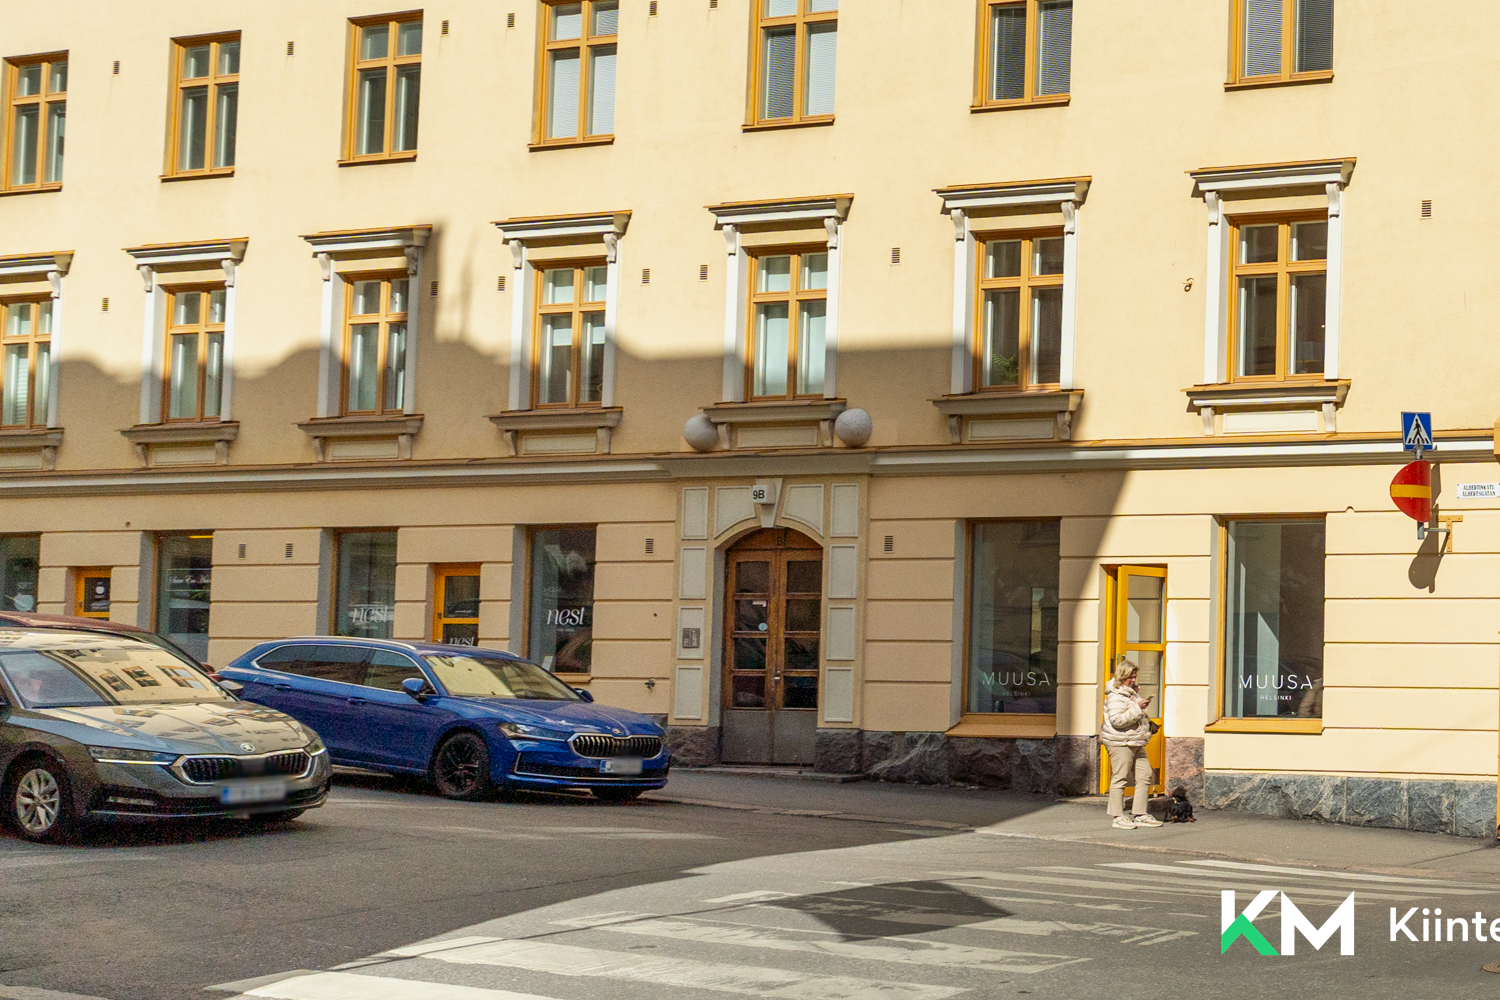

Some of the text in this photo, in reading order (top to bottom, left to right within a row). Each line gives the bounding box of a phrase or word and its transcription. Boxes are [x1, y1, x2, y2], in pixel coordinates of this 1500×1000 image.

[753, 489, 765, 500] 9B
[546, 607, 585, 626] nest
[982, 671, 1051, 686] MUUSA
[1238, 674, 1314, 690] MUUSA
